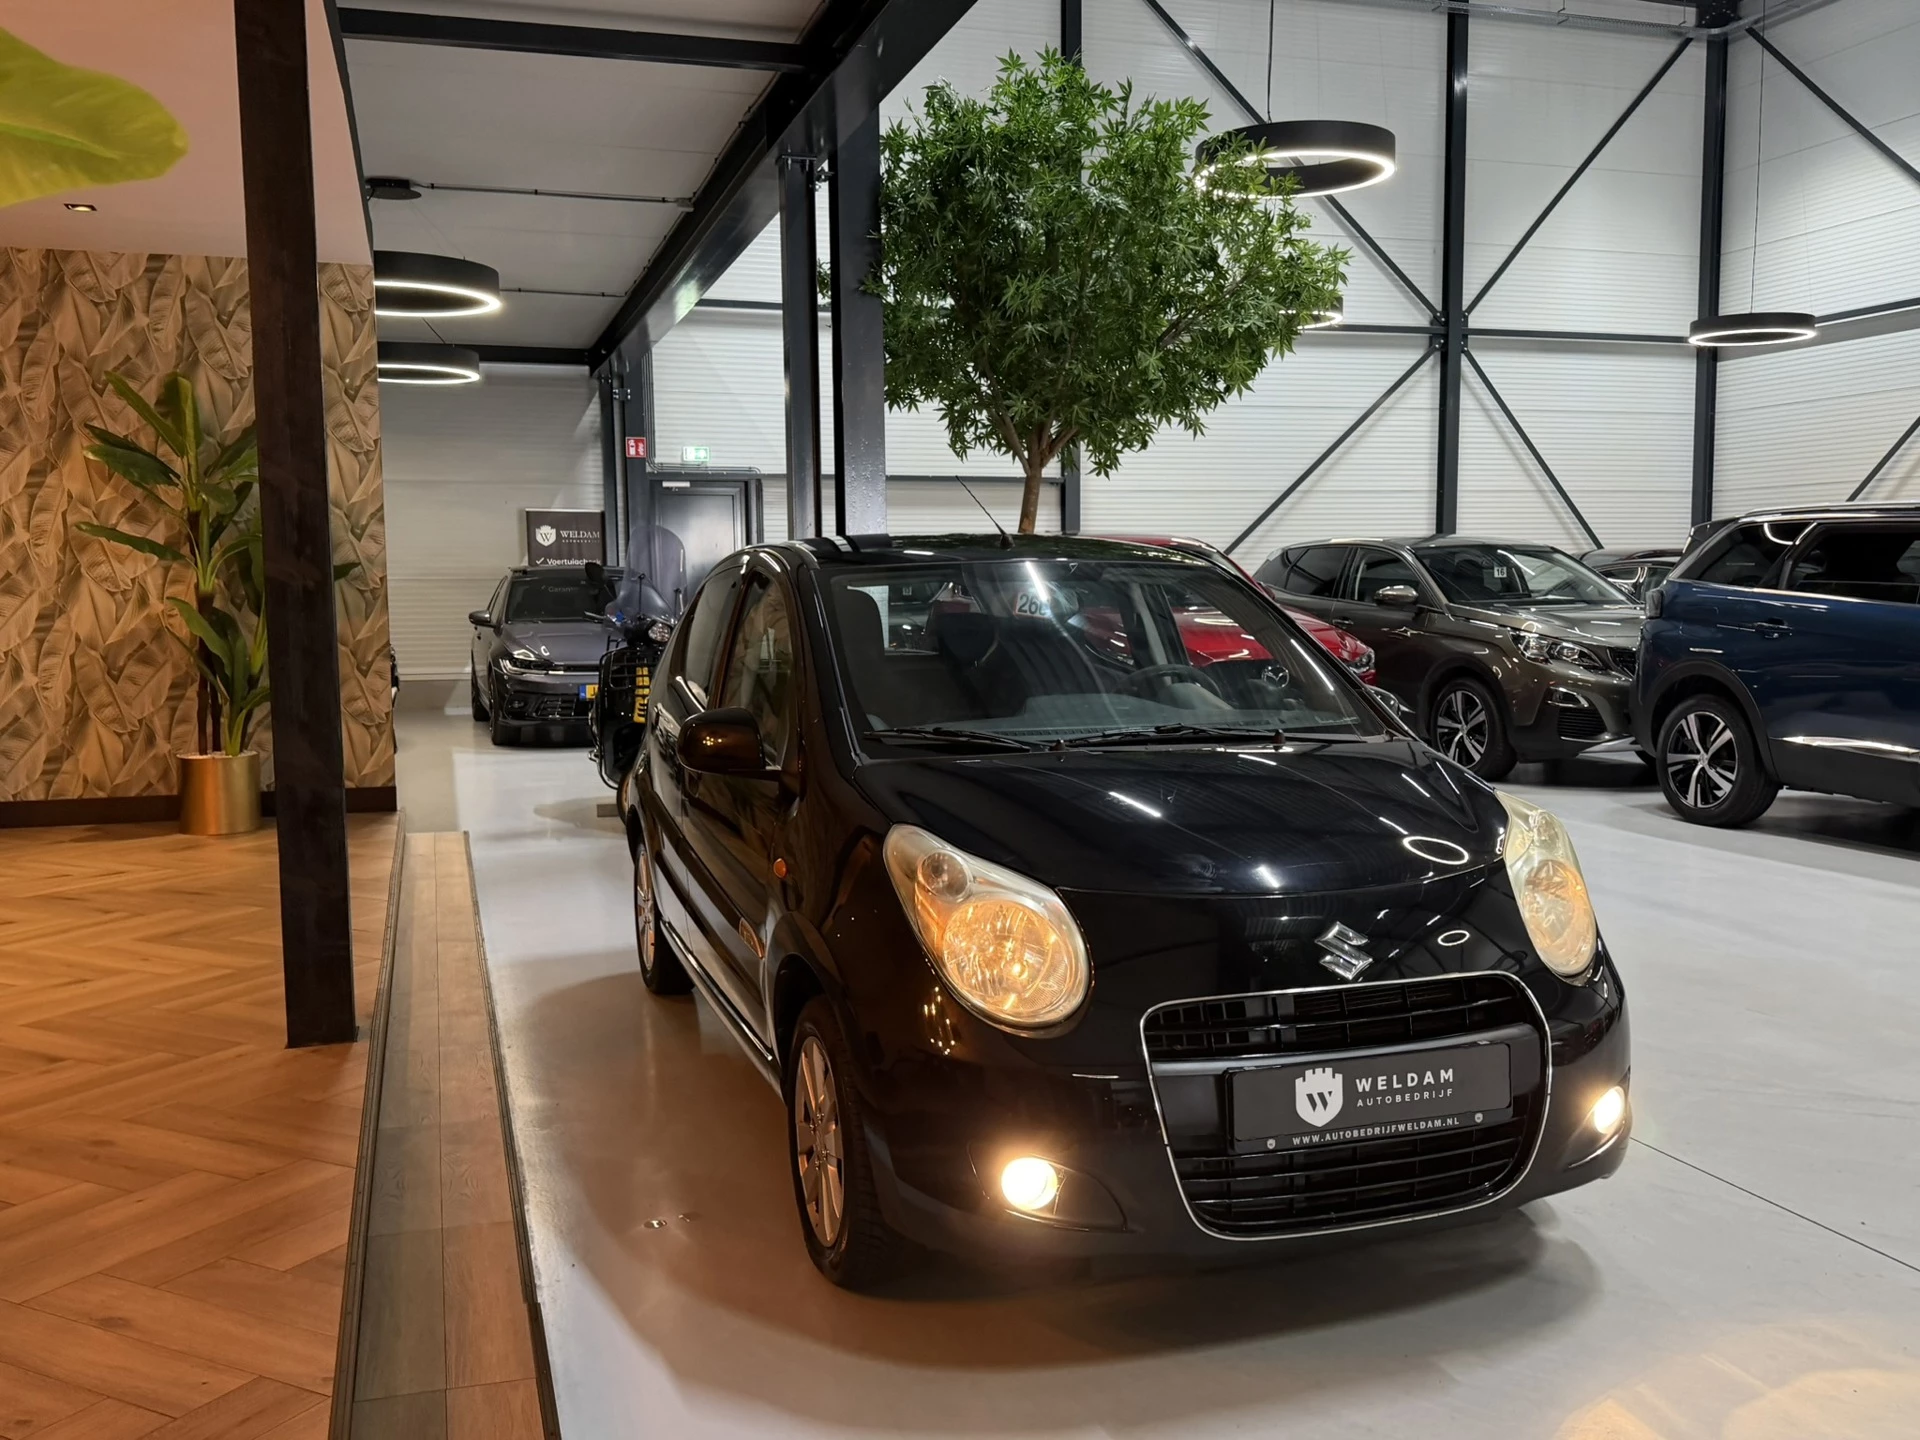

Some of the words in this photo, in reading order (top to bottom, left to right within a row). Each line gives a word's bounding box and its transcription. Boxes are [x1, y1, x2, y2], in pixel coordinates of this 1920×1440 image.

[560, 530, 600, 538] WELDAM
[1355, 1068, 1454, 1093] WELDAM
[1357, 1088, 1453, 1108] AUTOBEDRIJF
[1292, 1117, 1460, 1146] WWW.AUTOBEDRIJFWELDAM.NL
